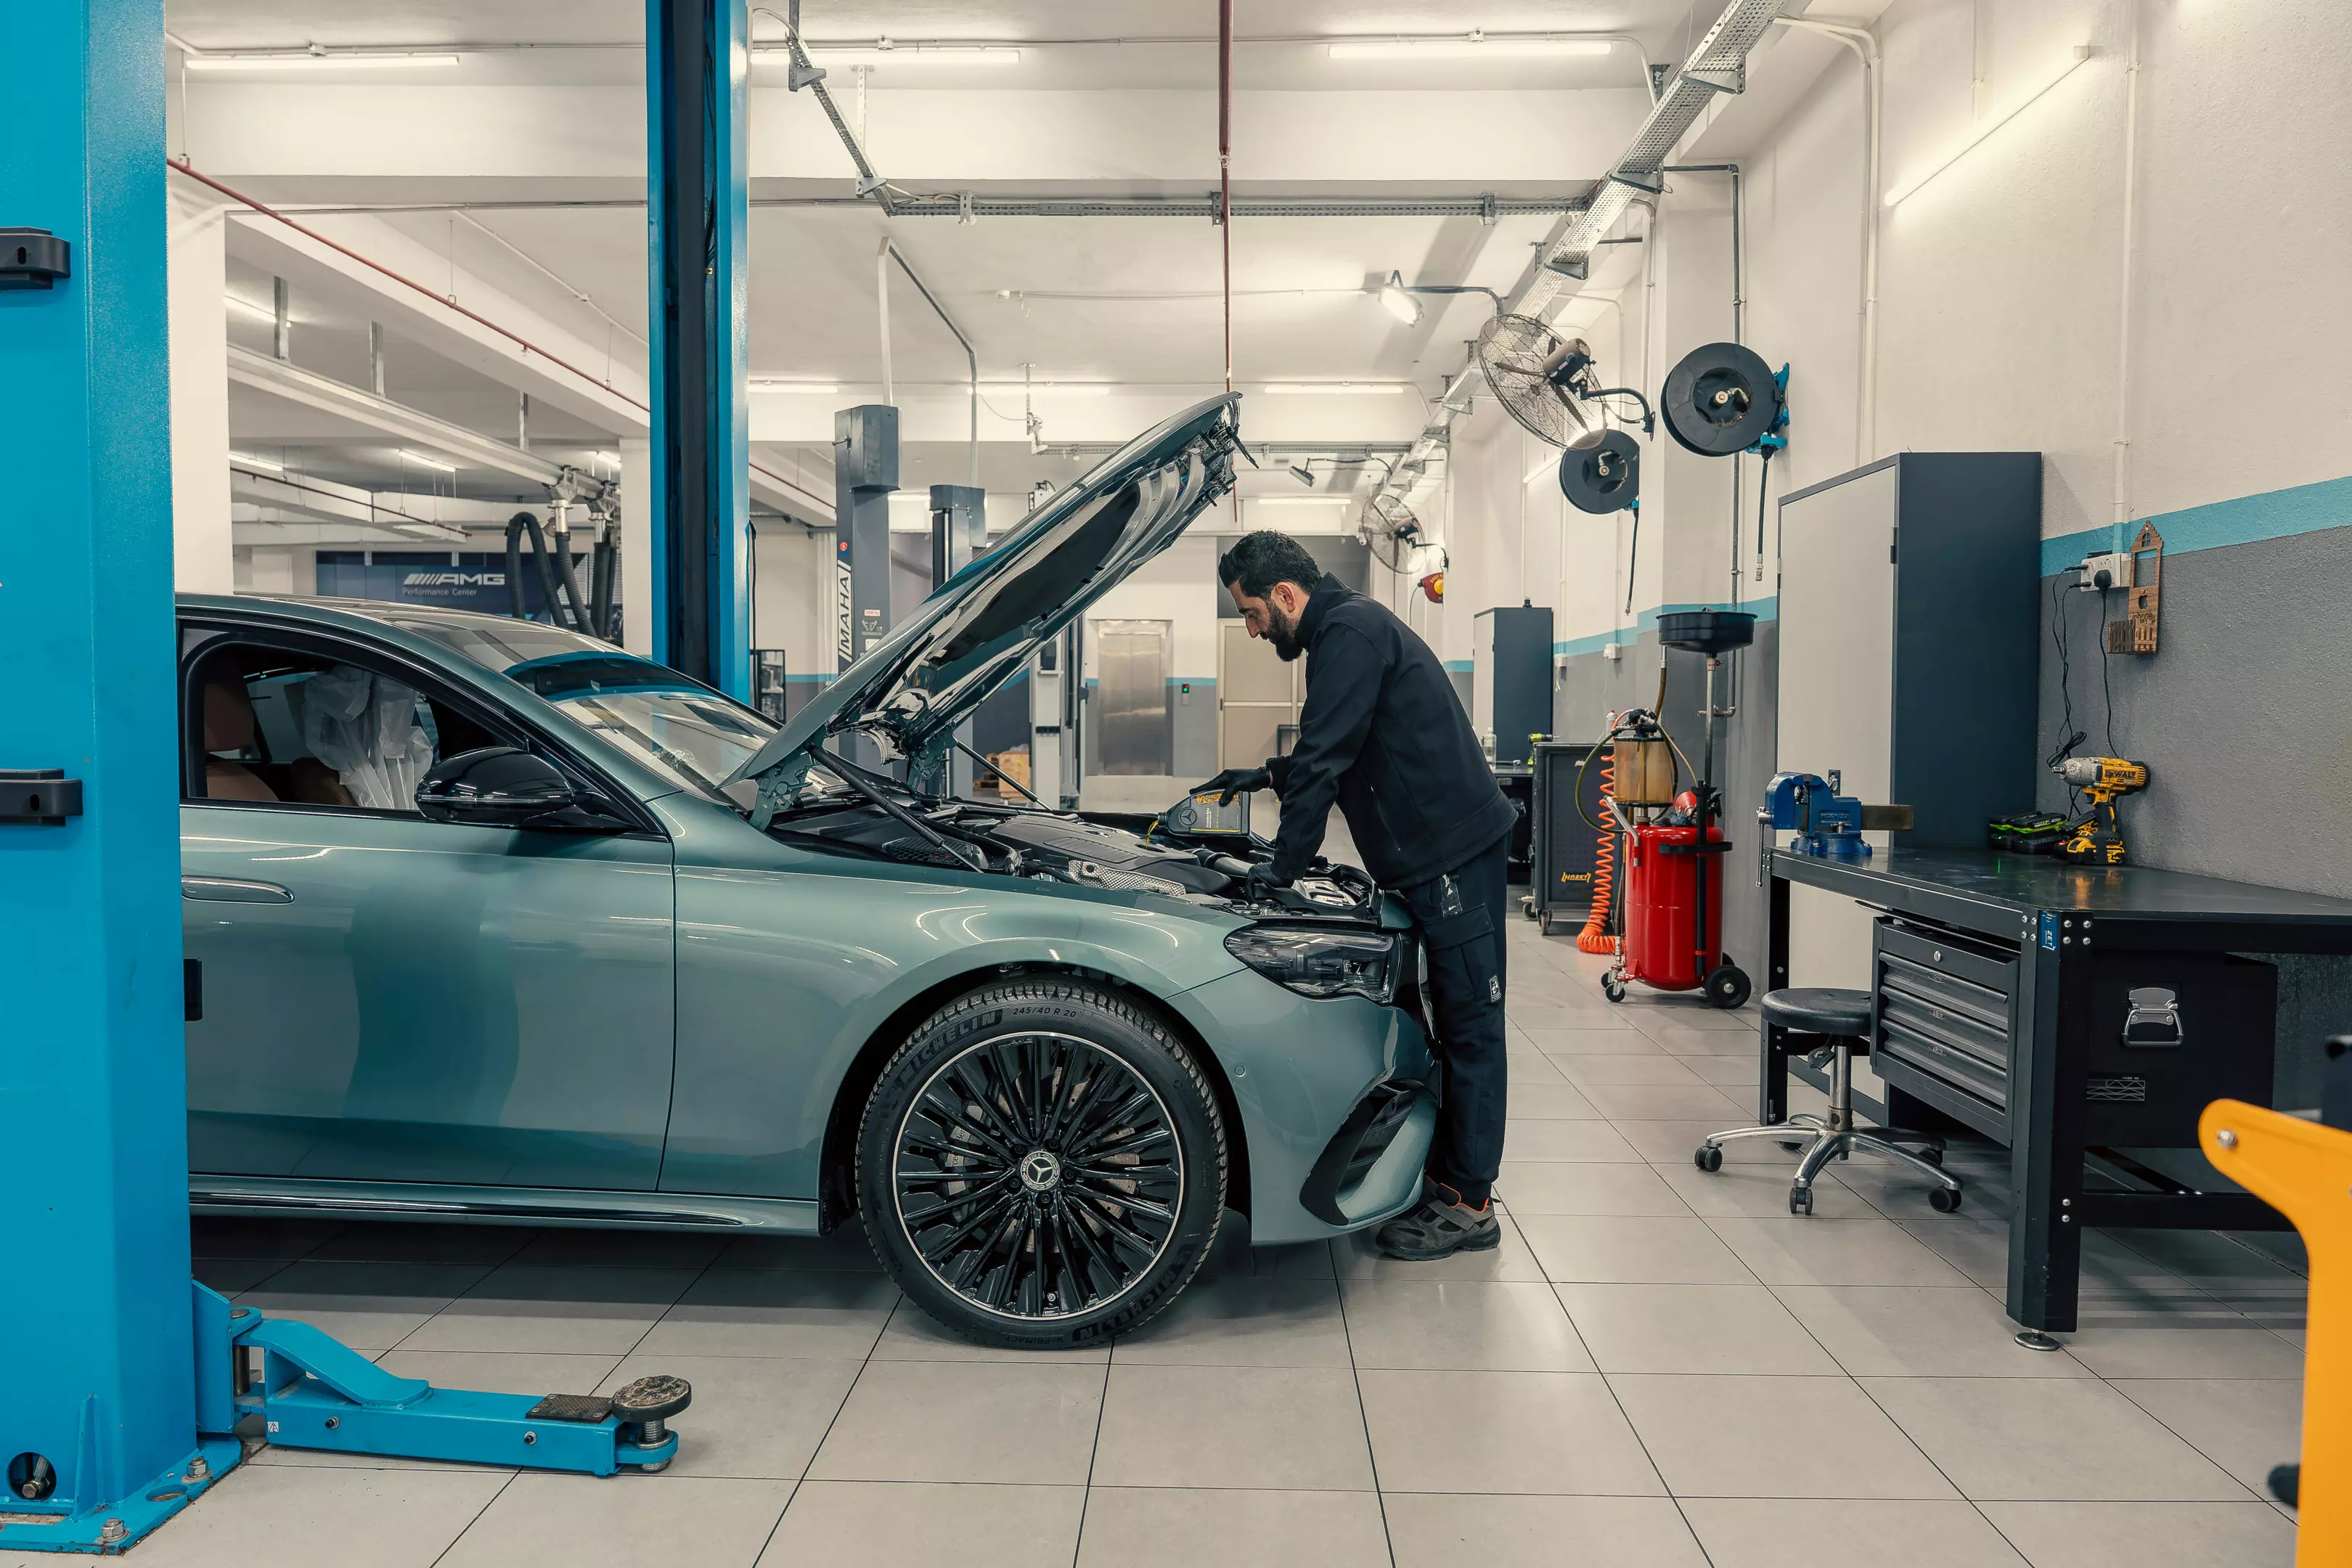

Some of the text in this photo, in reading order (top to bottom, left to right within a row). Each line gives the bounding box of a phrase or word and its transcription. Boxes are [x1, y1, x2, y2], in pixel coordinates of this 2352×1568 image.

[840, 576, 850, 650] MAHA
[1013, 1006, 1051, 1015] 245/40
[897, 1011, 997, 1087] MICHELIN
[1022, 1153, 1041, 1172] MERCEDES
[1045, 1177, 1058, 1188] BENZ
[1079, 1270, 1177, 1341] MICHELIN
